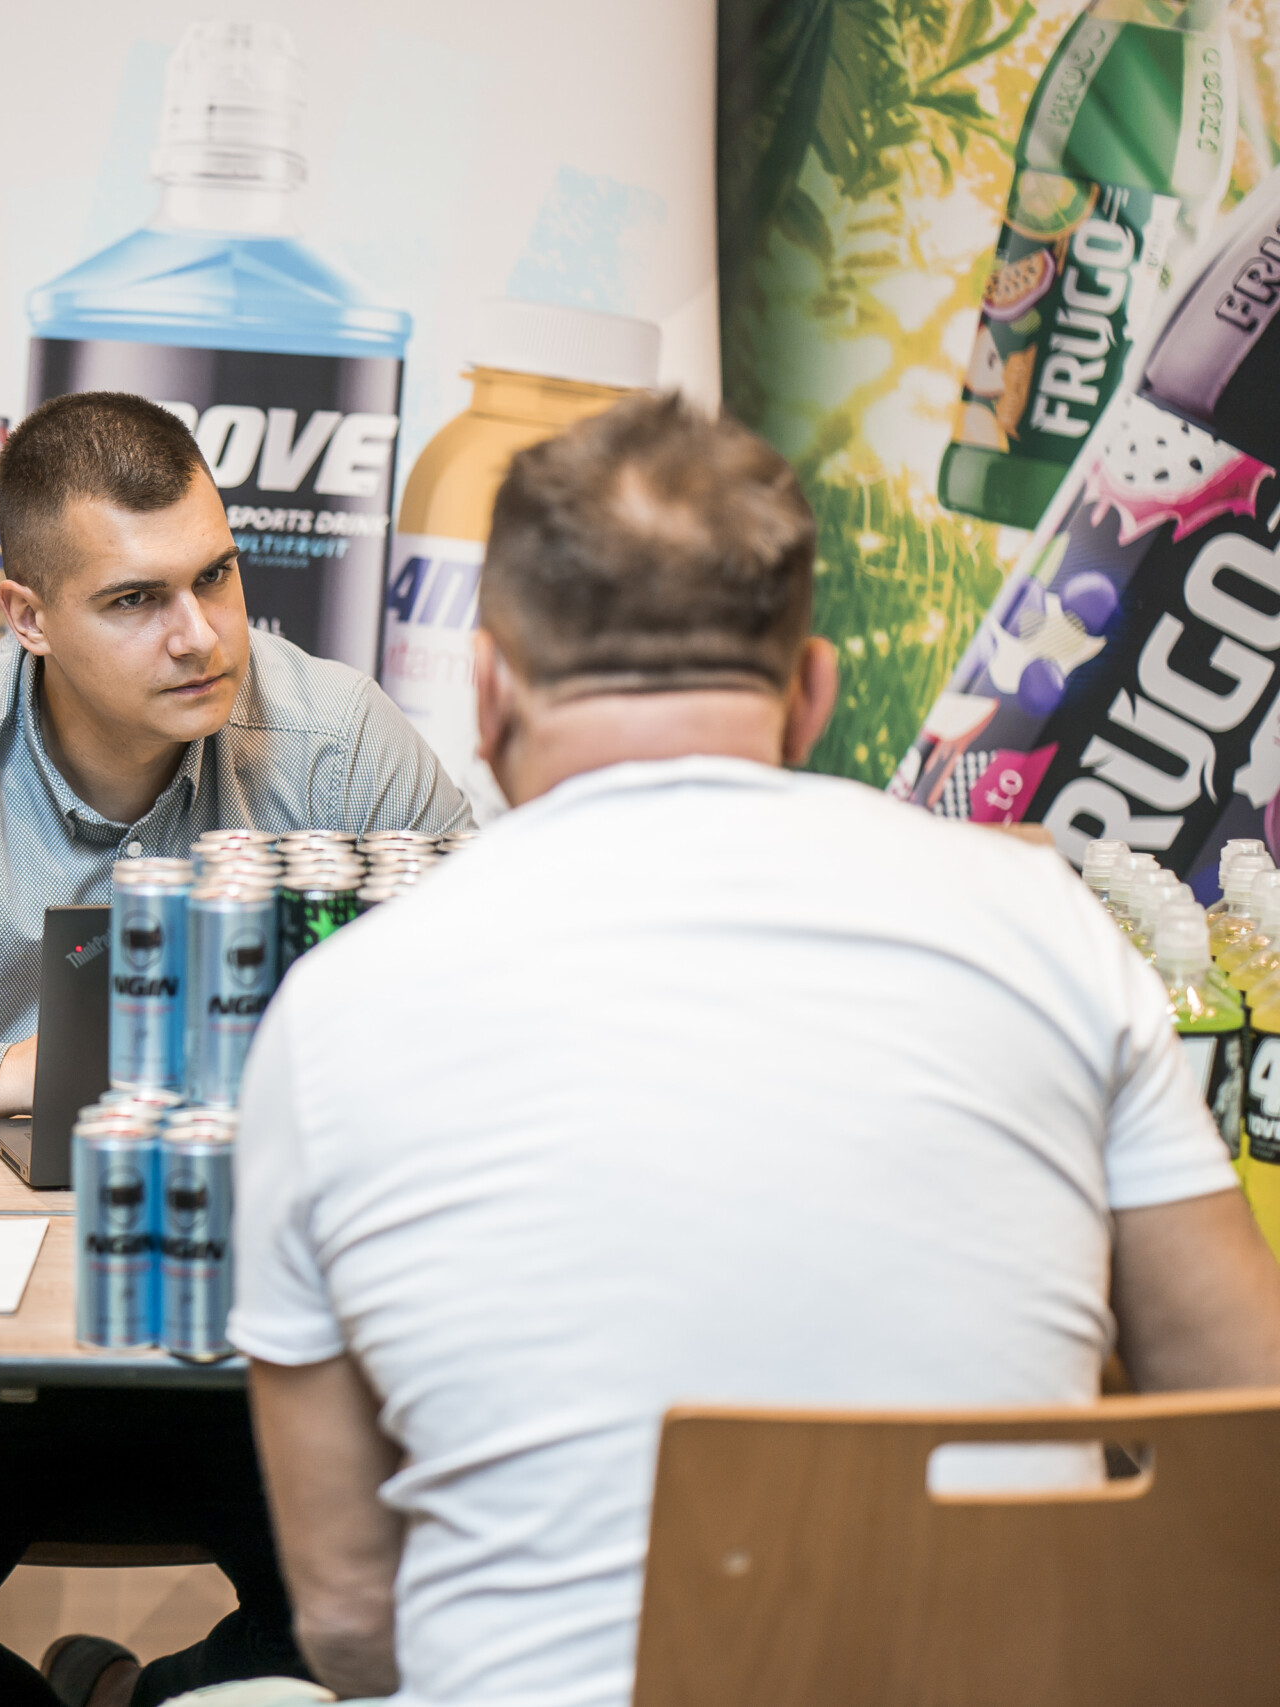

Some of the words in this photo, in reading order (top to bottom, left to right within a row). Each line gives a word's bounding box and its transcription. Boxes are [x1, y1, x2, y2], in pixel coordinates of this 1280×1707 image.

[1031, 218, 1135, 438] FRUGO
[158, 400, 400, 497] OVE
[226, 504, 314, 533] SPORTS
[314, 510, 391, 538] DRINK
[234, 532, 350, 559] ULTIFRUIT
[1042, 532, 1280, 870] RUGO
[65, 928, 112, 968] ThinkPa
